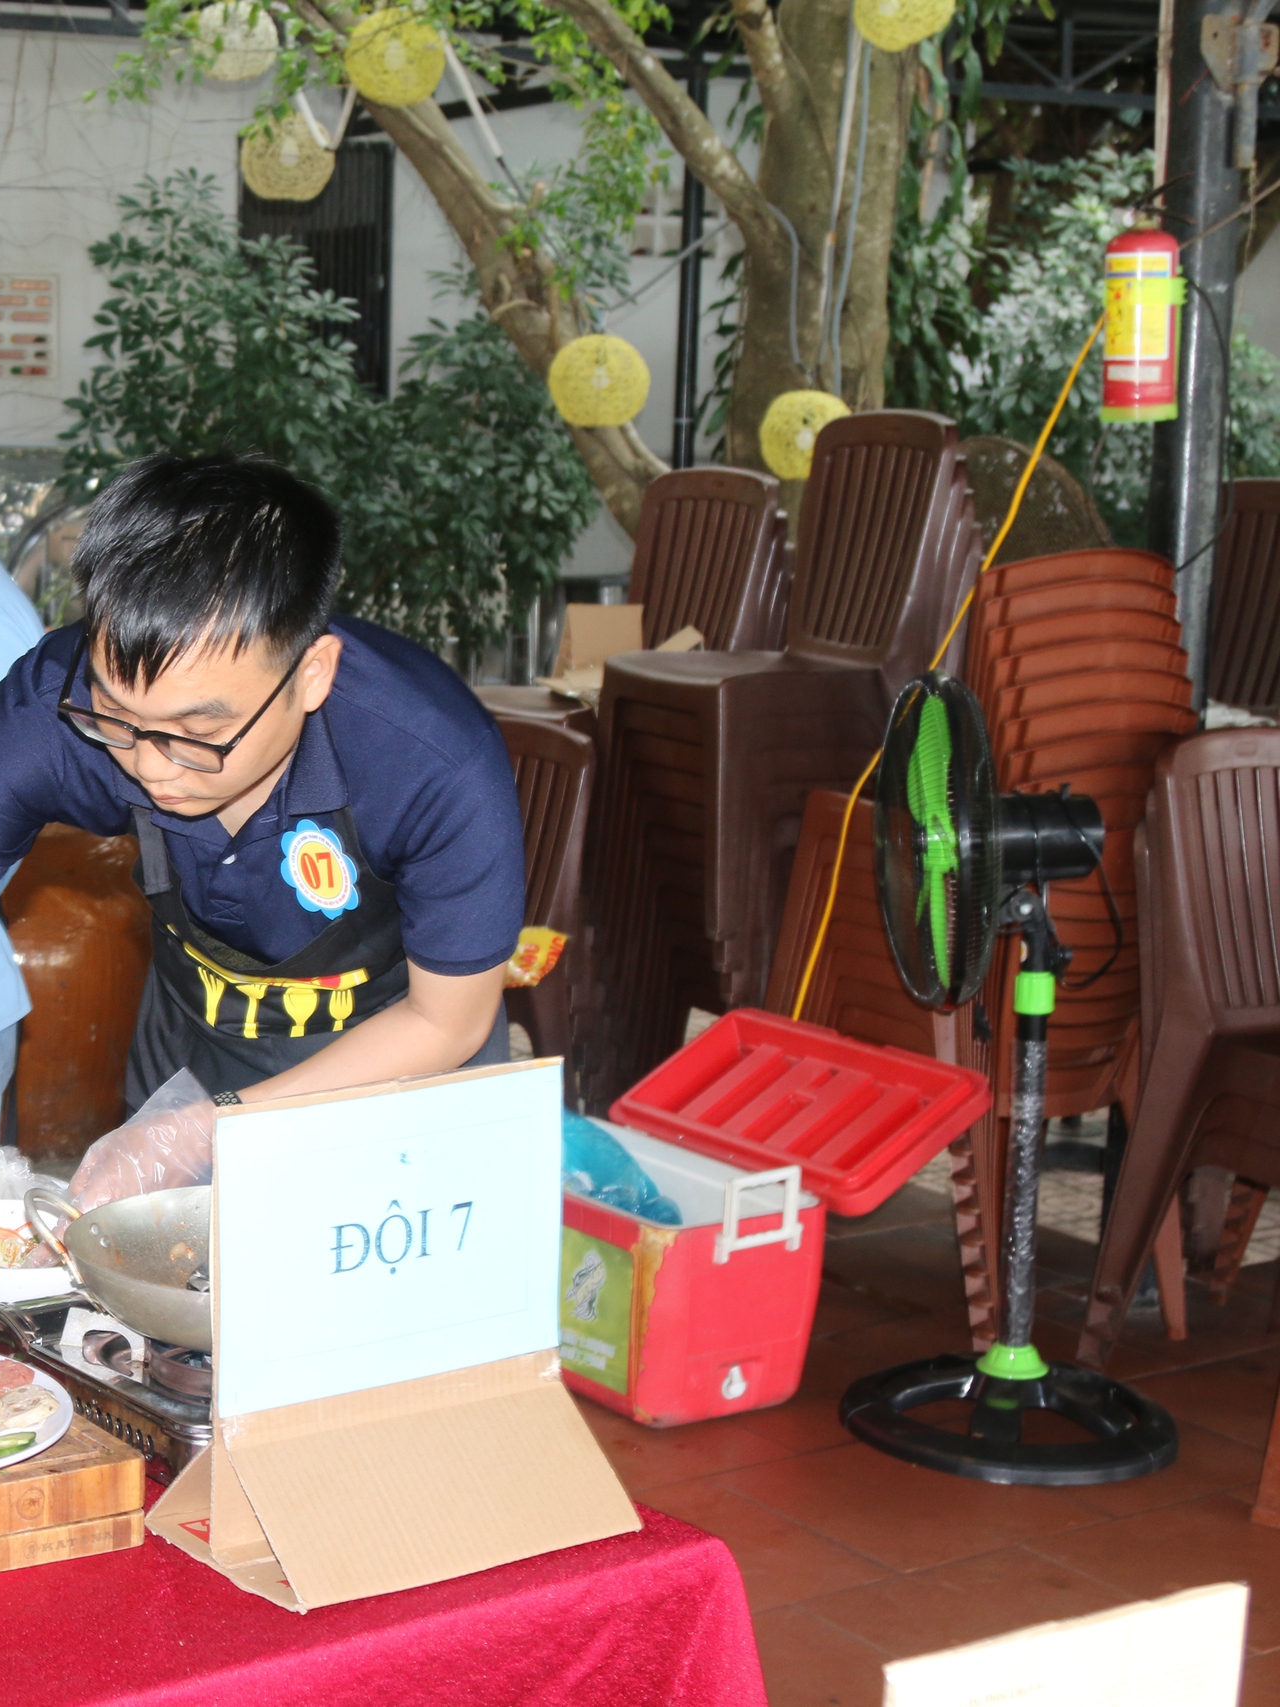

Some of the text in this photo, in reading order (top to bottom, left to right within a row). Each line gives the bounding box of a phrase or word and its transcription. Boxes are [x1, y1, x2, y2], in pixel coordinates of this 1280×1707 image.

[300, 851, 335, 890] 07
[330, 1199, 473, 1275] ĐỘI 7
